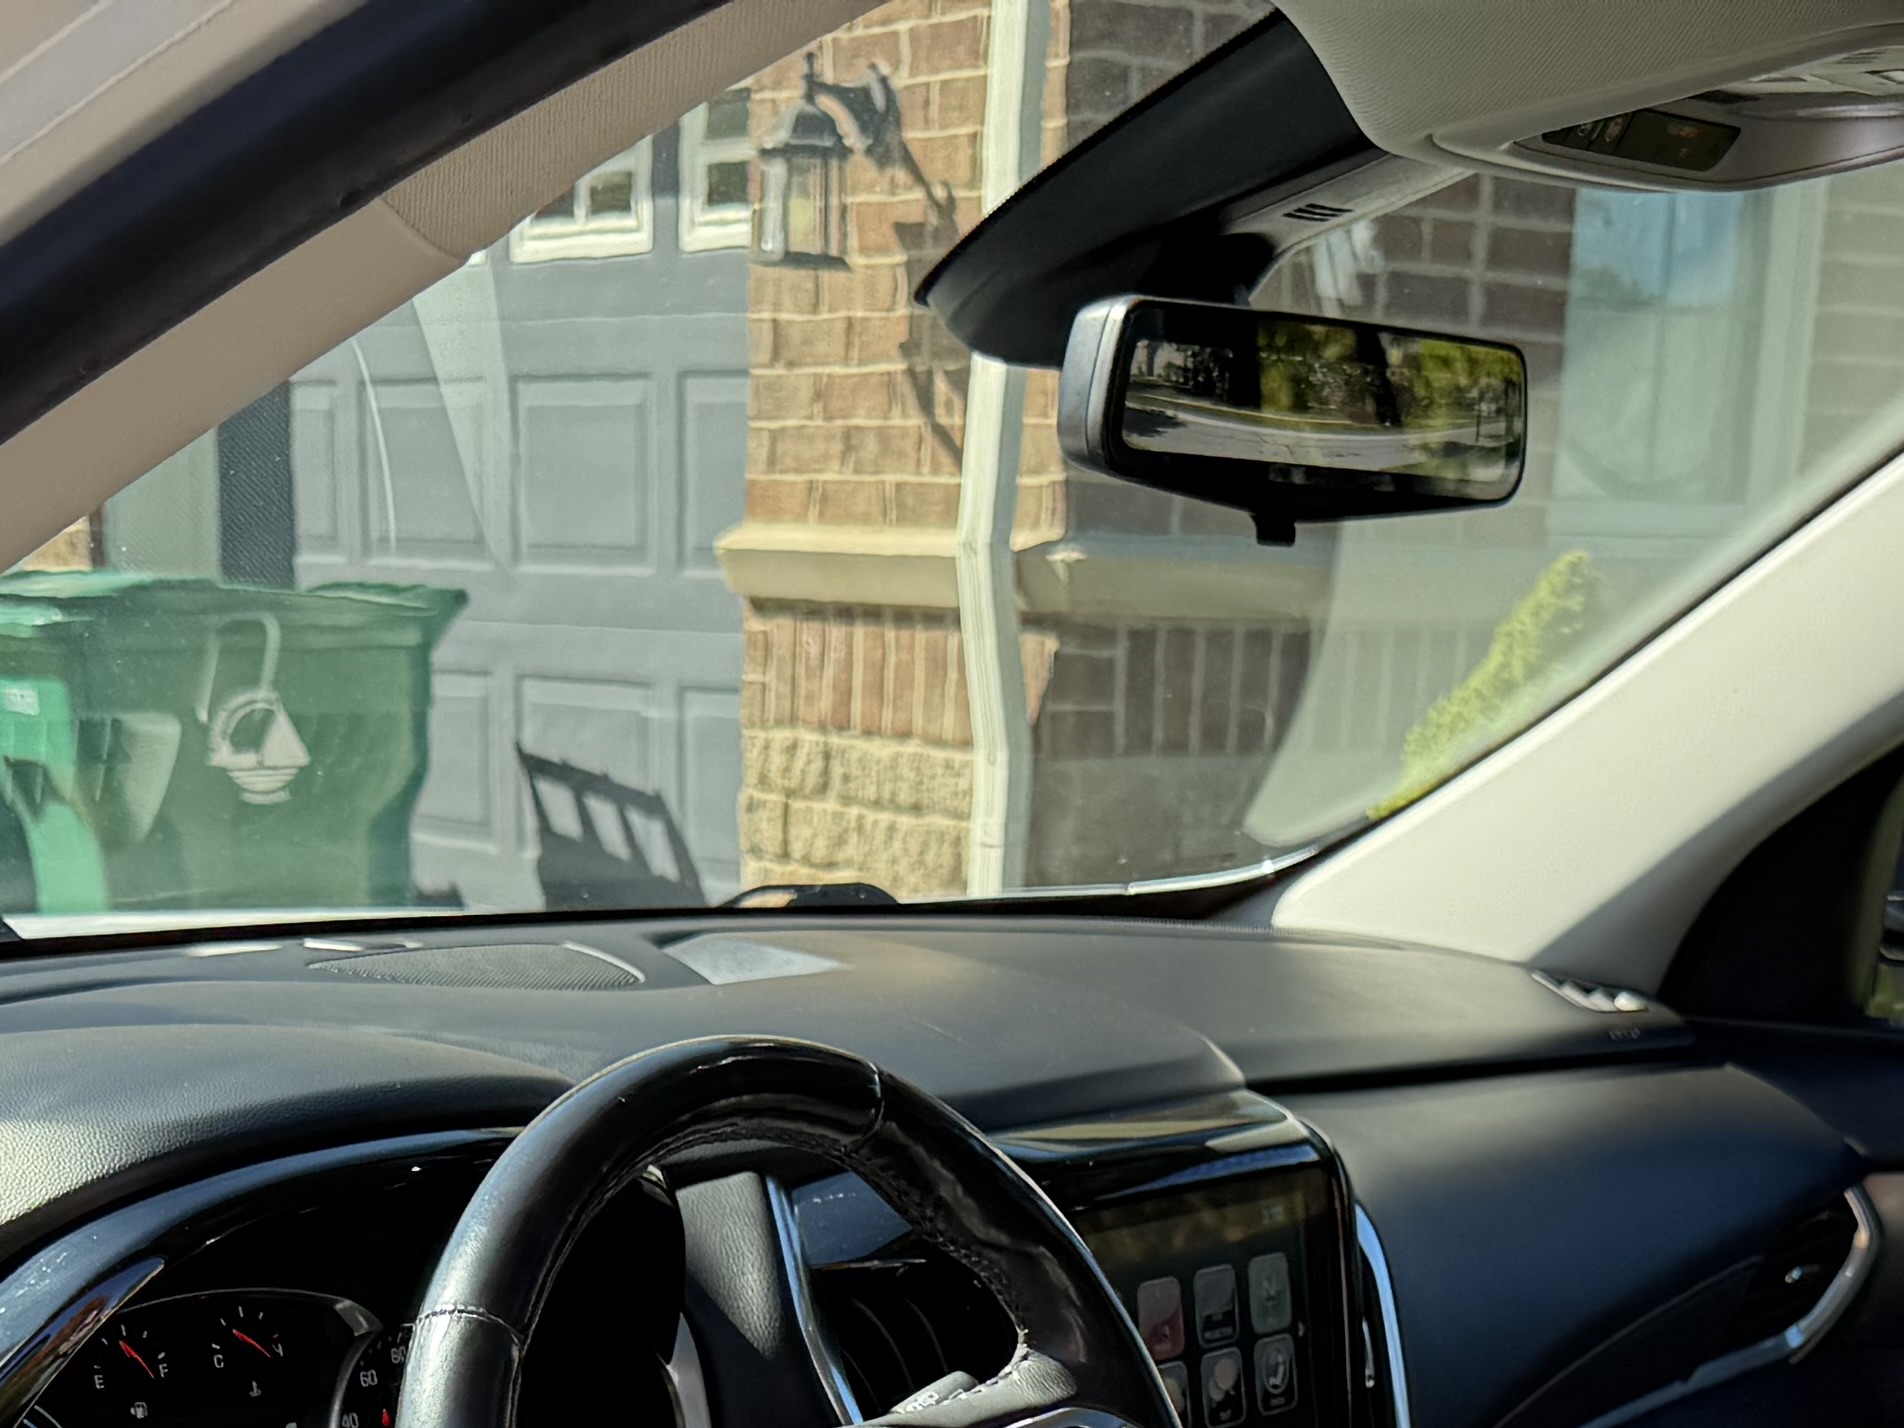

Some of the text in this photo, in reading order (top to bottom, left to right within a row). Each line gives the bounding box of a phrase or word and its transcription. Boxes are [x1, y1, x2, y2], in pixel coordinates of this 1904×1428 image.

[214, 1354, 224, 1368] C
[159, 1364, 169, 1378] F
[360, 1369, 378, 1387] 60
[94, 1375, 105, 1389] E
